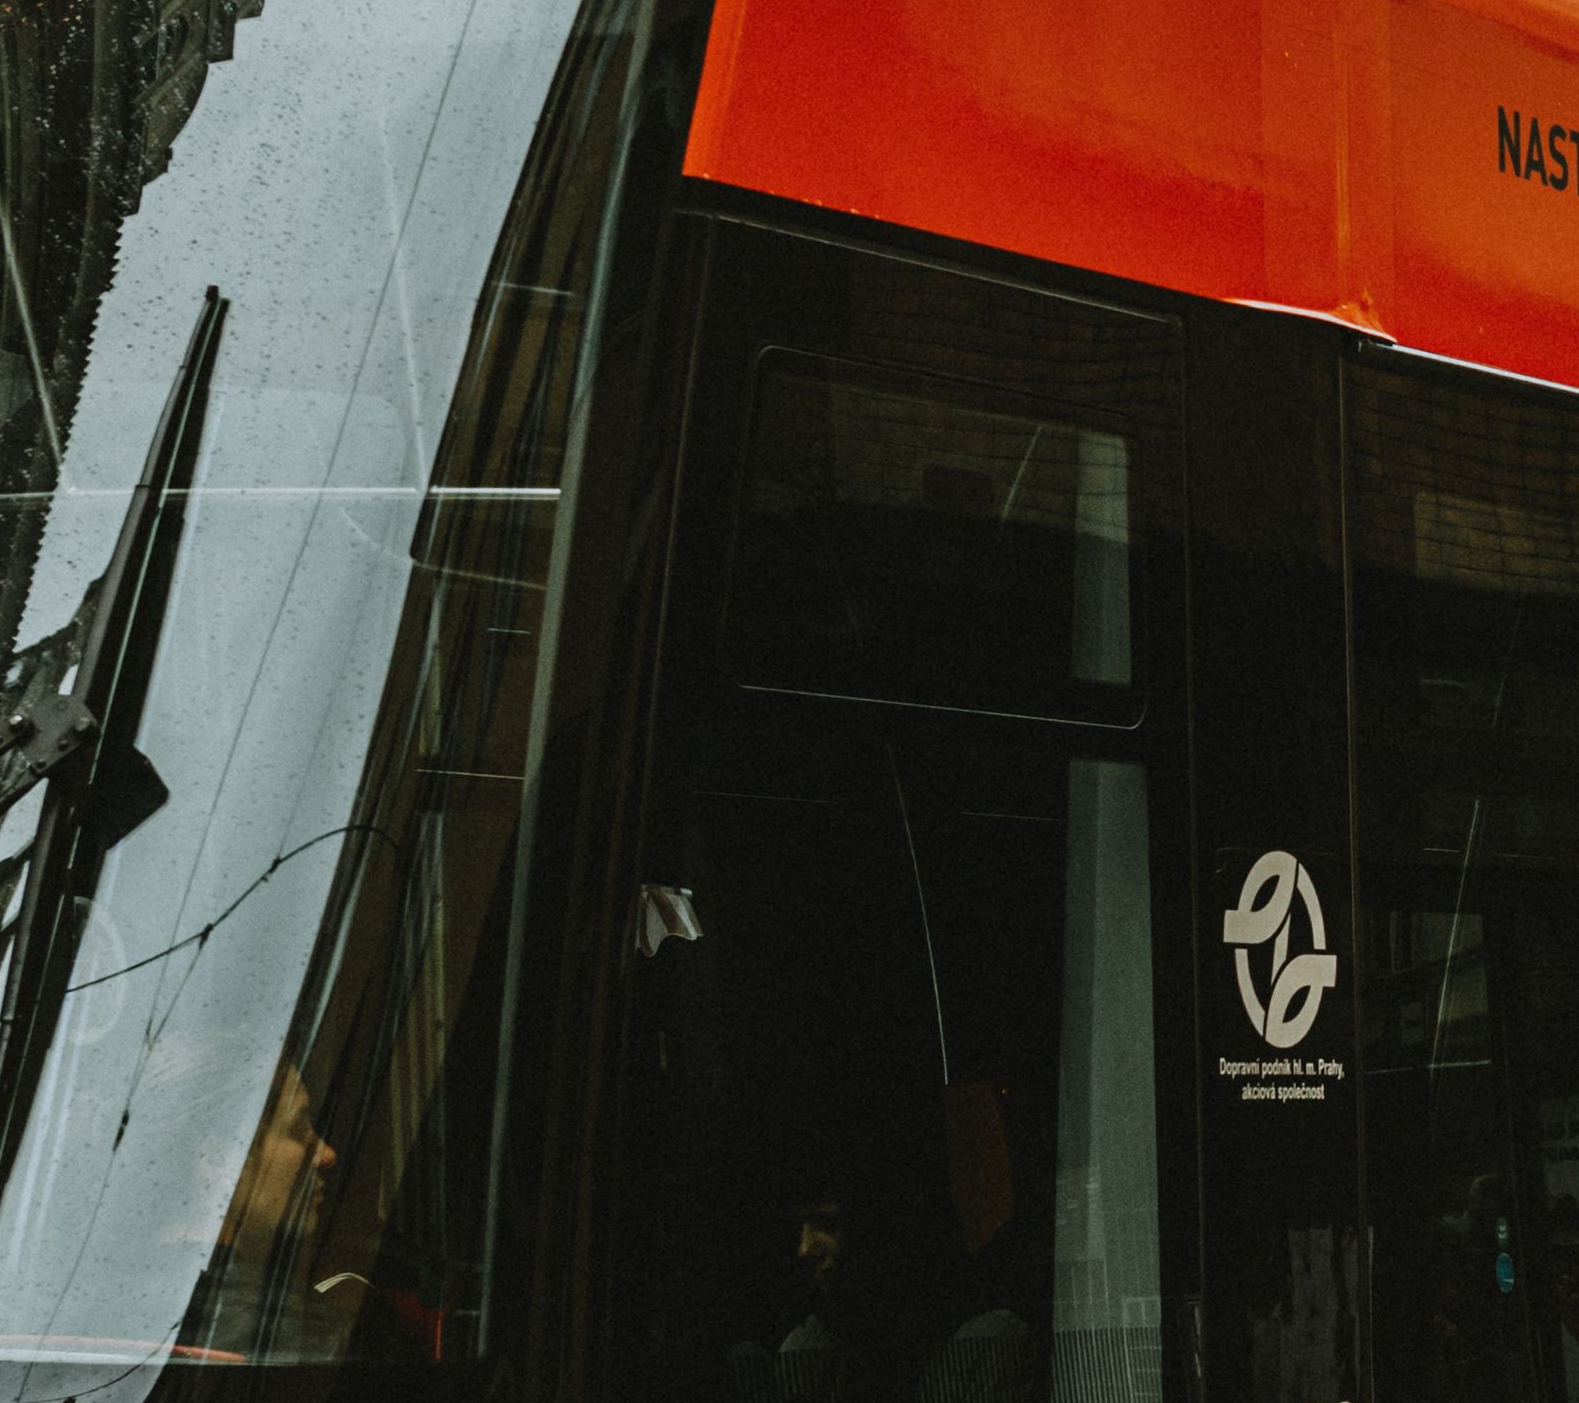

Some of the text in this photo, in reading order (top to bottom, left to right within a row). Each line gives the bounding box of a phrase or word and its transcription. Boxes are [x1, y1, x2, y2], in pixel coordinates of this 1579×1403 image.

[1219, 1057, 1261, 1080] Dopravní
[1261, 1057, 1292, 1080] podnik
[1292, 1058, 1304, 1075] hl.
[1305, 1062, 1317, 1075] m.
[1241, 1082, 1326, 1103] akciová společnost
